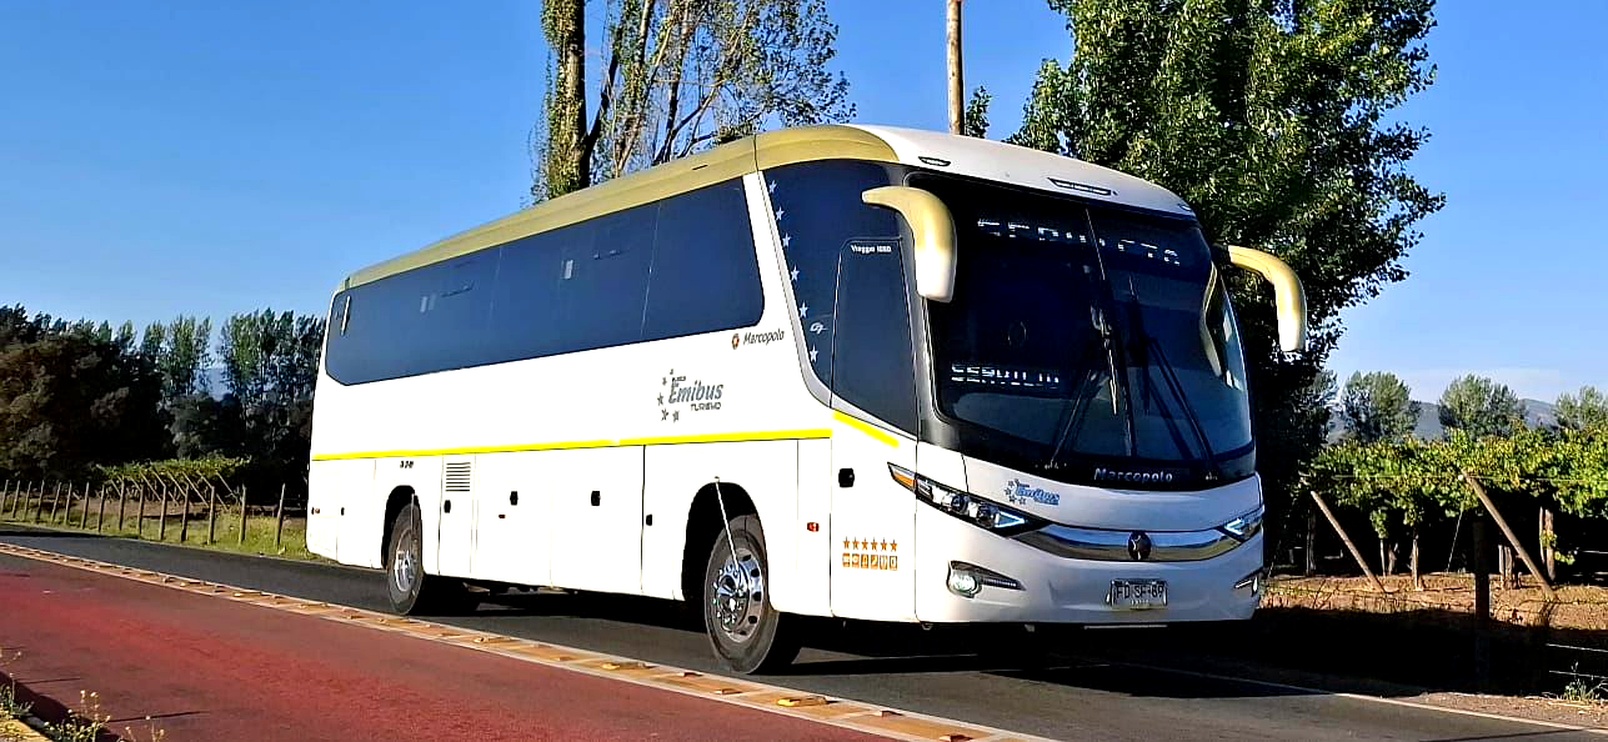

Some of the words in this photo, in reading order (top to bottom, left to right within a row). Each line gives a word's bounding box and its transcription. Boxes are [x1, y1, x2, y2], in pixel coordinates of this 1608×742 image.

[742, 328, 785, 346] Marcopolo
[667, 377, 724, 404] Emibus
[1093, 467, 1174, 485] Marcopolo
